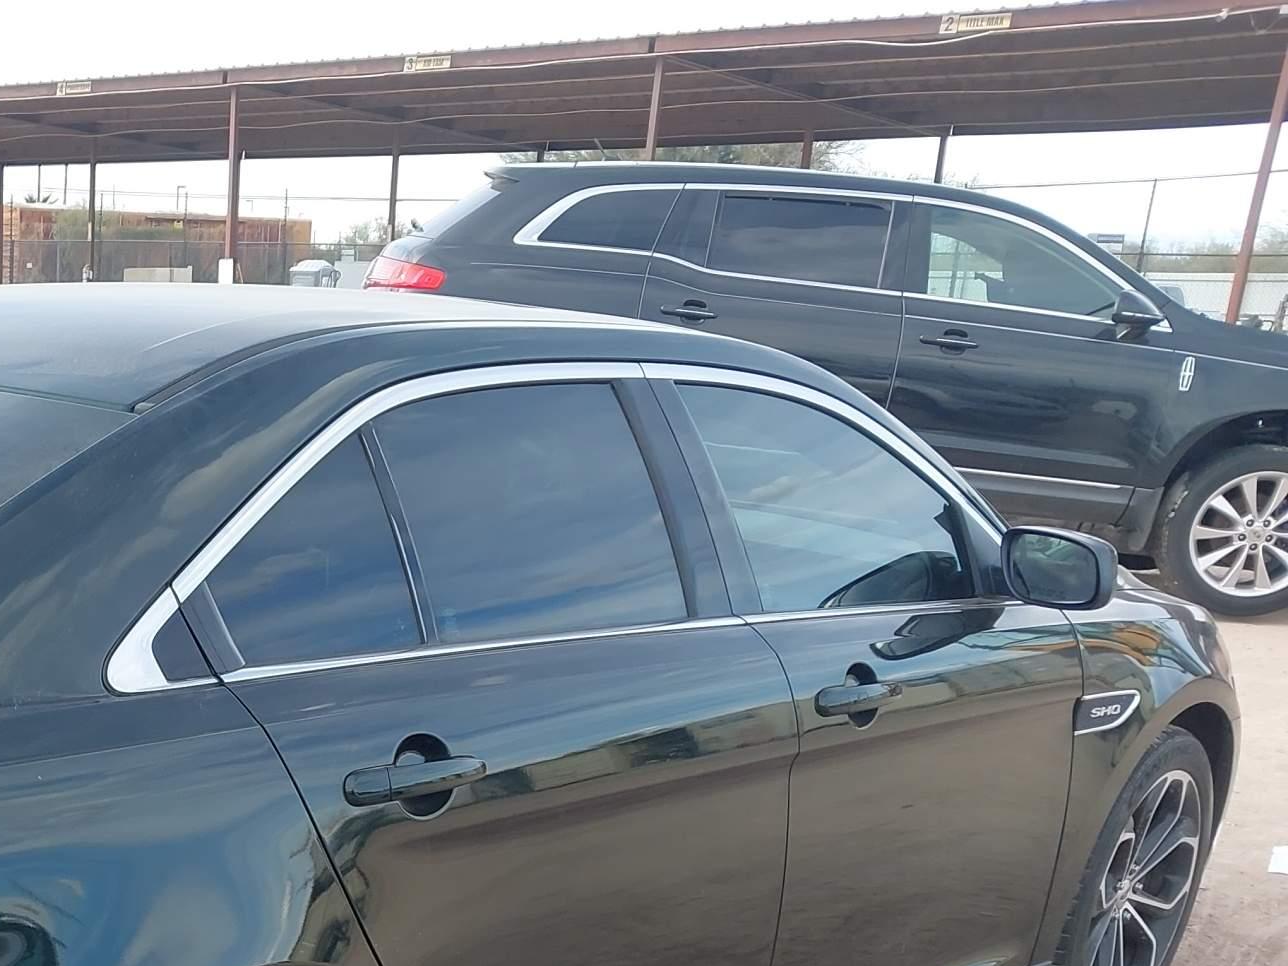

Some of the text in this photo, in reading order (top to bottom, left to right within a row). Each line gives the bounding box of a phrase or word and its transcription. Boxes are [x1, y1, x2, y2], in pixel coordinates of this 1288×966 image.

[943, 16, 955, 32] 2
[406, 58, 414, 71] 3
[1089, 704, 1121, 718] SHO
